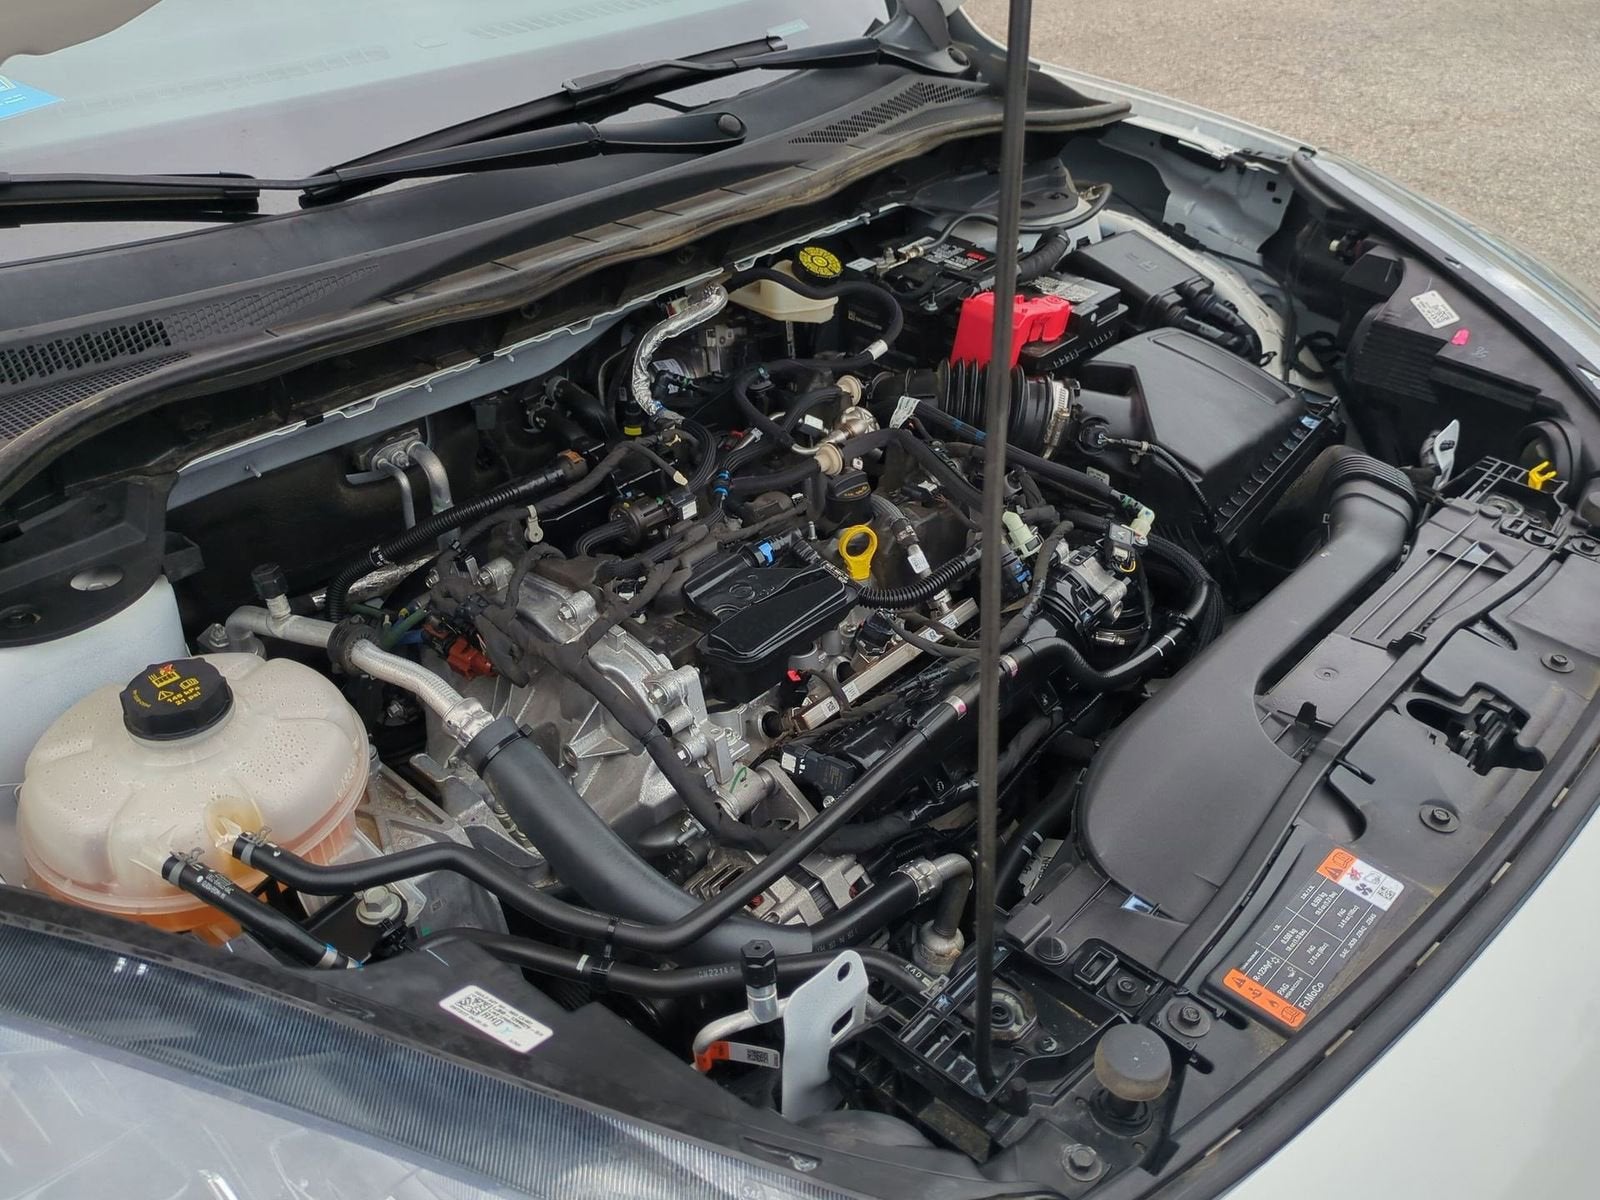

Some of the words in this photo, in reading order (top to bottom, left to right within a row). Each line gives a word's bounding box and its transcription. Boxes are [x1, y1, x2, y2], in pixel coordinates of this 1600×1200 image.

[188, 691, 202, 701] psi
[1288, 926, 1298, 935] kg
[1338, 946, 1351, 959] SAE
[1251, 959, 1274, 983] R-1234yf
[1276, 981, 1290, 996] PAG
[1297, 979, 1325, 1010] FoMoCo
